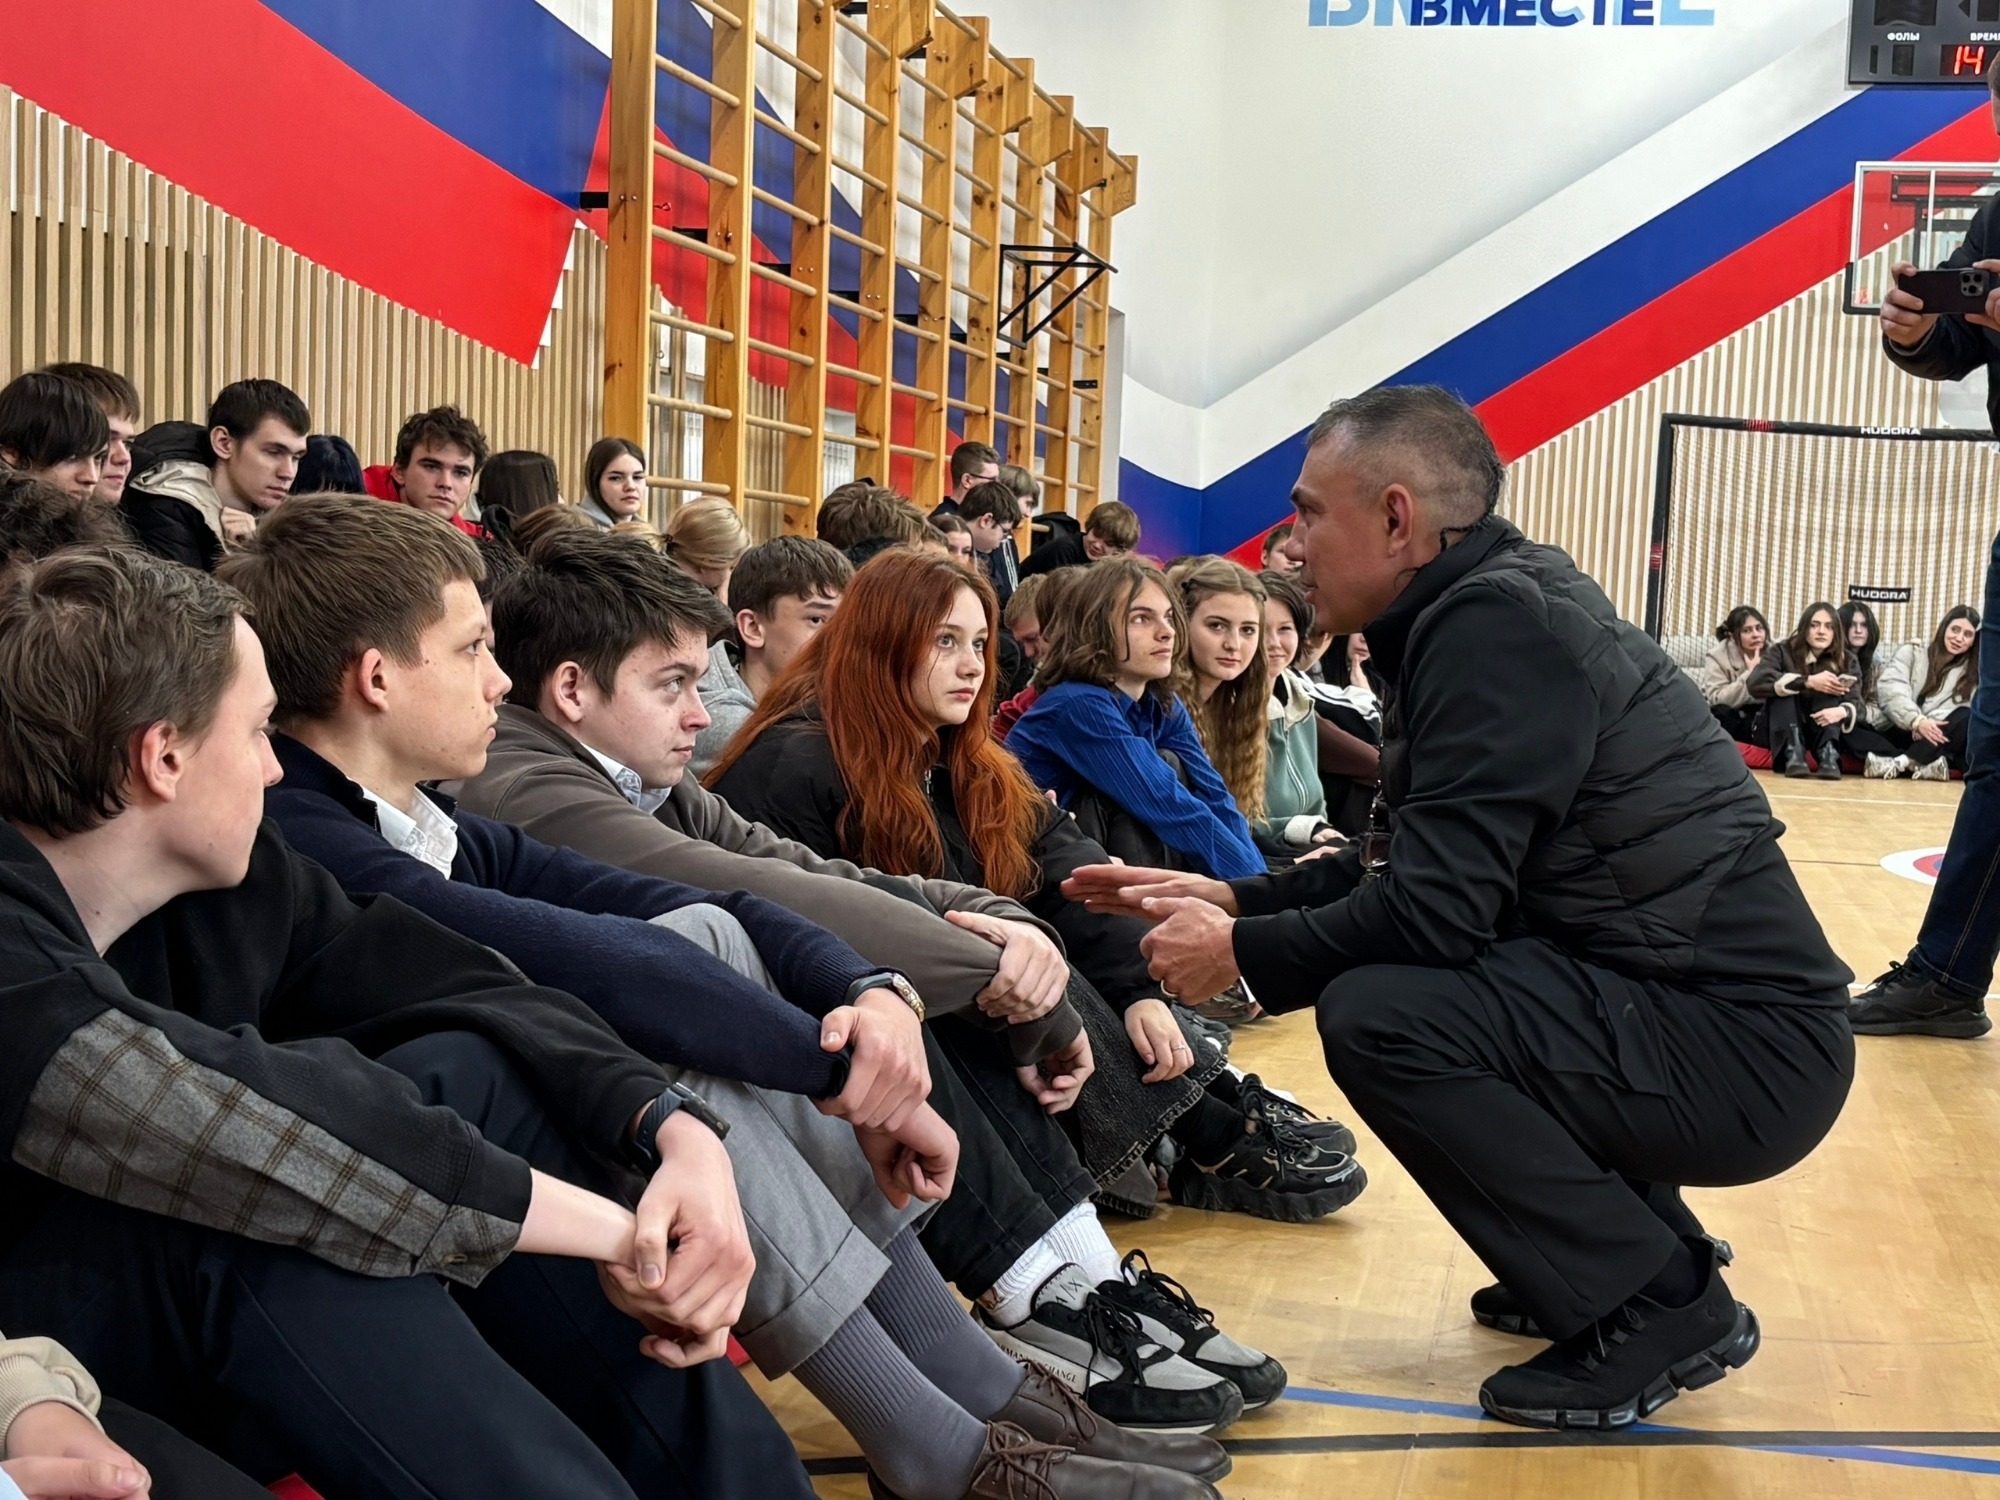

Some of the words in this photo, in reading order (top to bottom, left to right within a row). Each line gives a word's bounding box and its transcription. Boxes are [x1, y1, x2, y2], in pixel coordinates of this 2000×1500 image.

[1887, 32, 1920, 41] ФОЛЫ
[1970, 32, 2000, 41] ВРЕМ
[1953, 45, 1985, 75] 14
[1860, 426, 1921, 436] HUDORA
[1851, 588, 1908, 600] HUDORA
[996, 1341, 1030, 1360] RMAN
